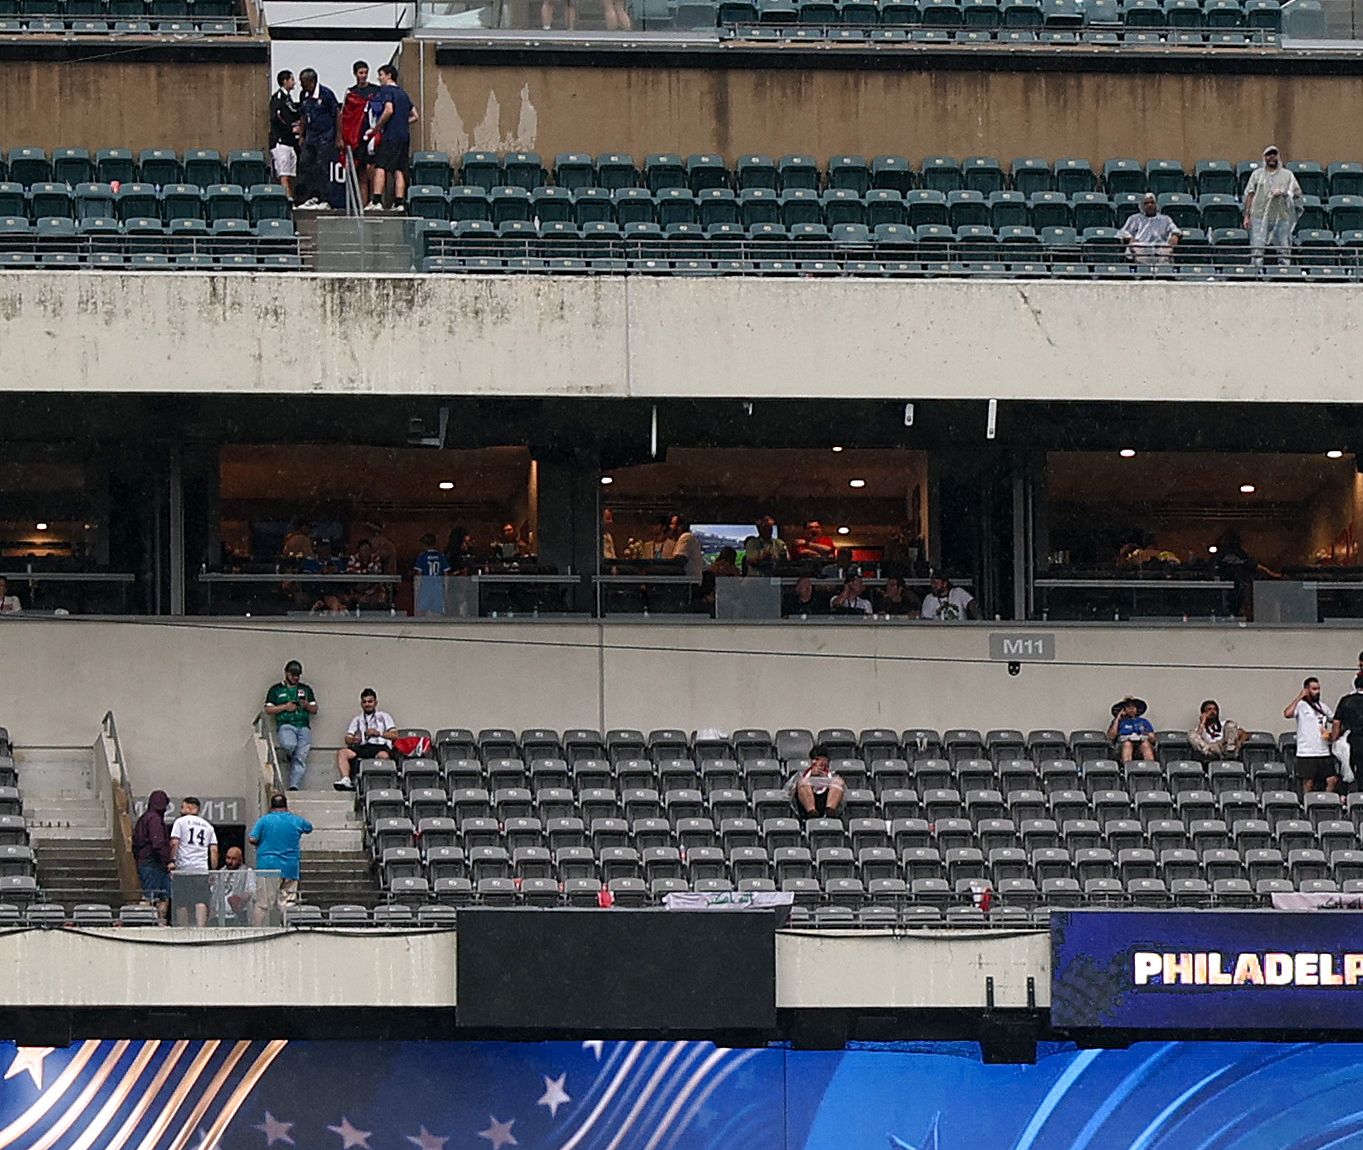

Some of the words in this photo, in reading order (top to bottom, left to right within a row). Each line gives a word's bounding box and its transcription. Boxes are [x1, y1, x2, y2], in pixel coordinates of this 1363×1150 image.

[330, 161, 346, 183] 10
[1003, 639, 1043, 654] M11
[187, 826, 205, 846] 14
